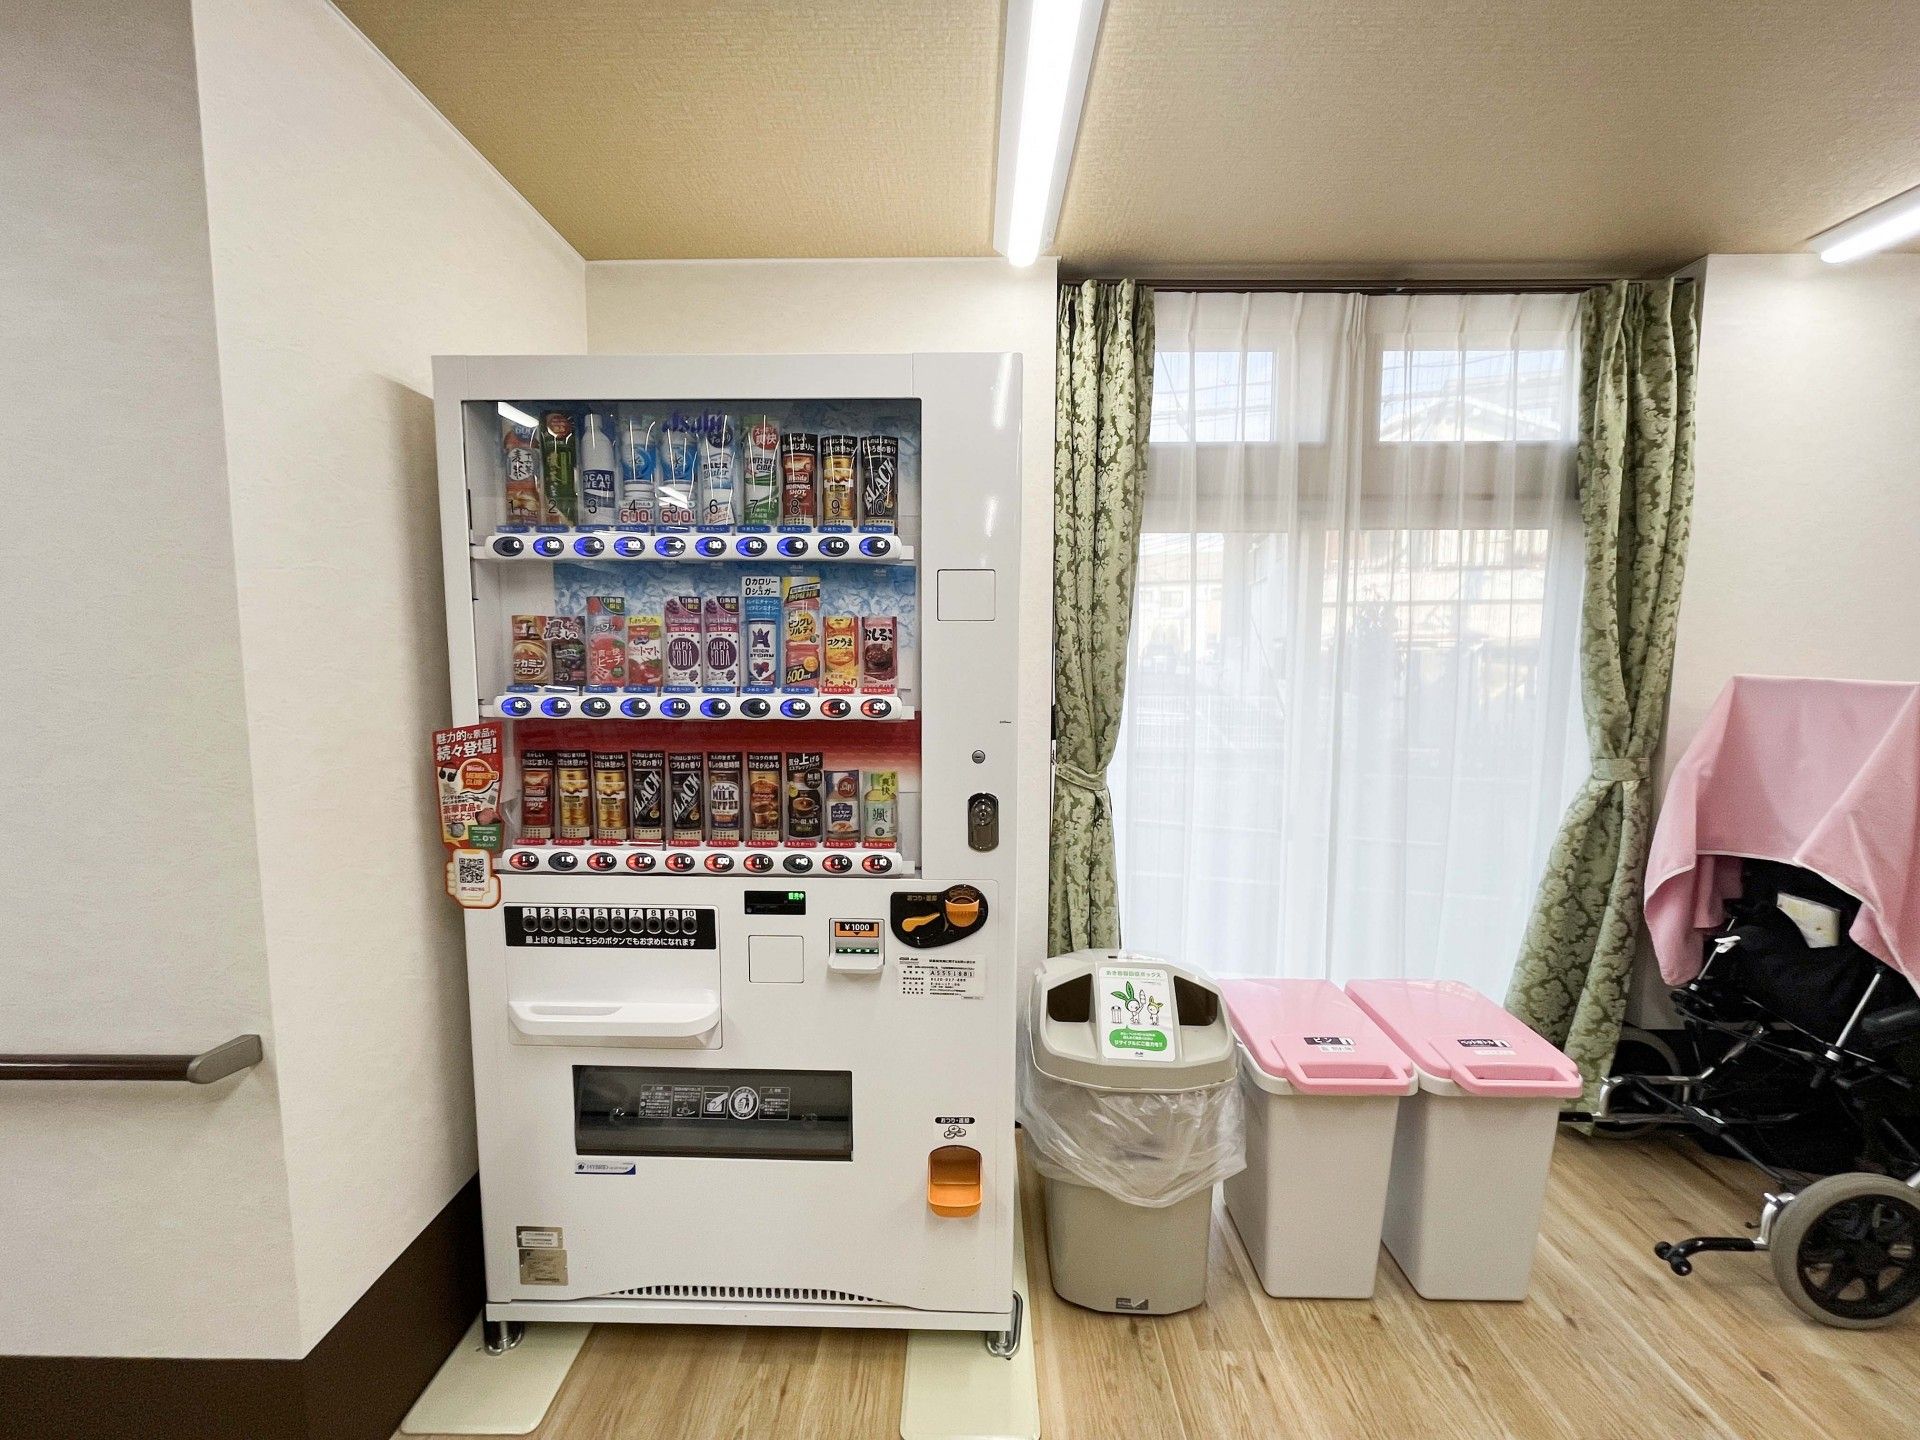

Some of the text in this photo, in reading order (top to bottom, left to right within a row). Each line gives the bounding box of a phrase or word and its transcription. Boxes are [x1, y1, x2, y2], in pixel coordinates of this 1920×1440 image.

[863, 458, 895, 510] BLACK
[508, 500, 514, 513] 1
[548, 500, 557, 514] 2
[588, 499, 598, 514] 3
[628, 500, 637, 513] 4
[669, 501, 678, 514] 5
[709, 499, 718, 514] 6
[750, 500, 758, 514] 7
[790, 499, 800, 515] 8
[831, 499, 840, 515] 9
[870, 499, 885, 515] 10
[621, 510, 649, 523] 600
[661, 510, 691, 523] 600
[745, 578, 777, 586] 0カロリー
[745, 587, 777, 596] 0シュガー
[827, 637, 853, 647] コクうま
[640, 646, 660, 656] トマト
[672, 650, 693, 666] SODA
[710, 650, 730, 666] SODA
[634, 770, 662, 819] BLACK
[673, 772, 701, 822] BLACK
[713, 790, 735, 800] MILK
[525, 936, 696, 947] 最上段の商品はこちらのボタンでもお求めになれます
